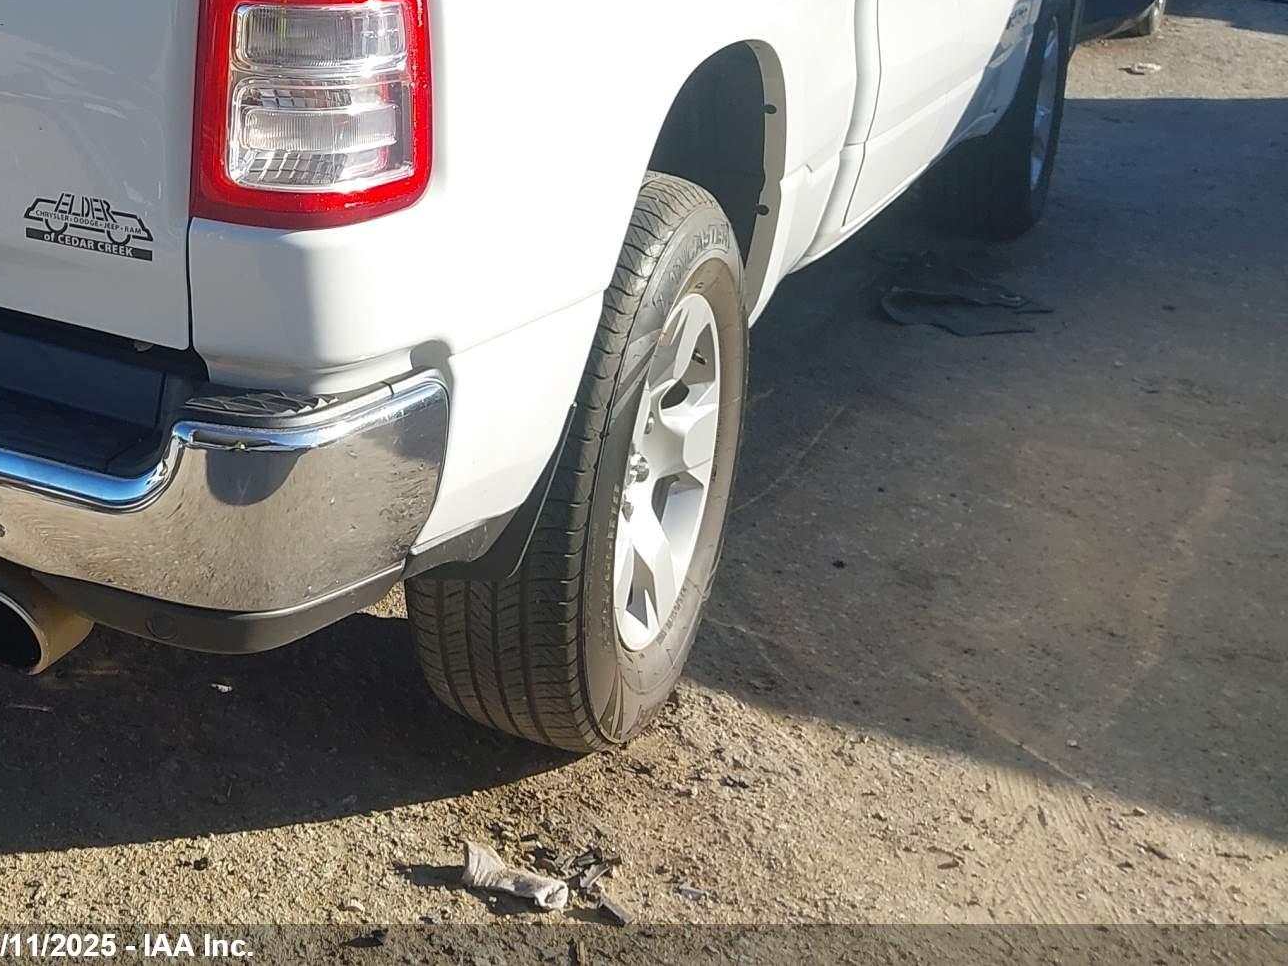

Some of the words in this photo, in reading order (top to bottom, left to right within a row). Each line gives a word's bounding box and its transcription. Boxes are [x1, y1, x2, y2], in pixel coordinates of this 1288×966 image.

[55, 192, 117, 223] ELDER
[35, 209, 69, 222] CHRYSLER
[73, 216, 99, 228] DODGE
[103, 221, 120, 231] JEEP
[124, 225, 142, 235] RAM
[43, 232, 56, 243] of
[58, 234, 95, 251] CEDAR
[97, 241, 134, 258] CREEK
